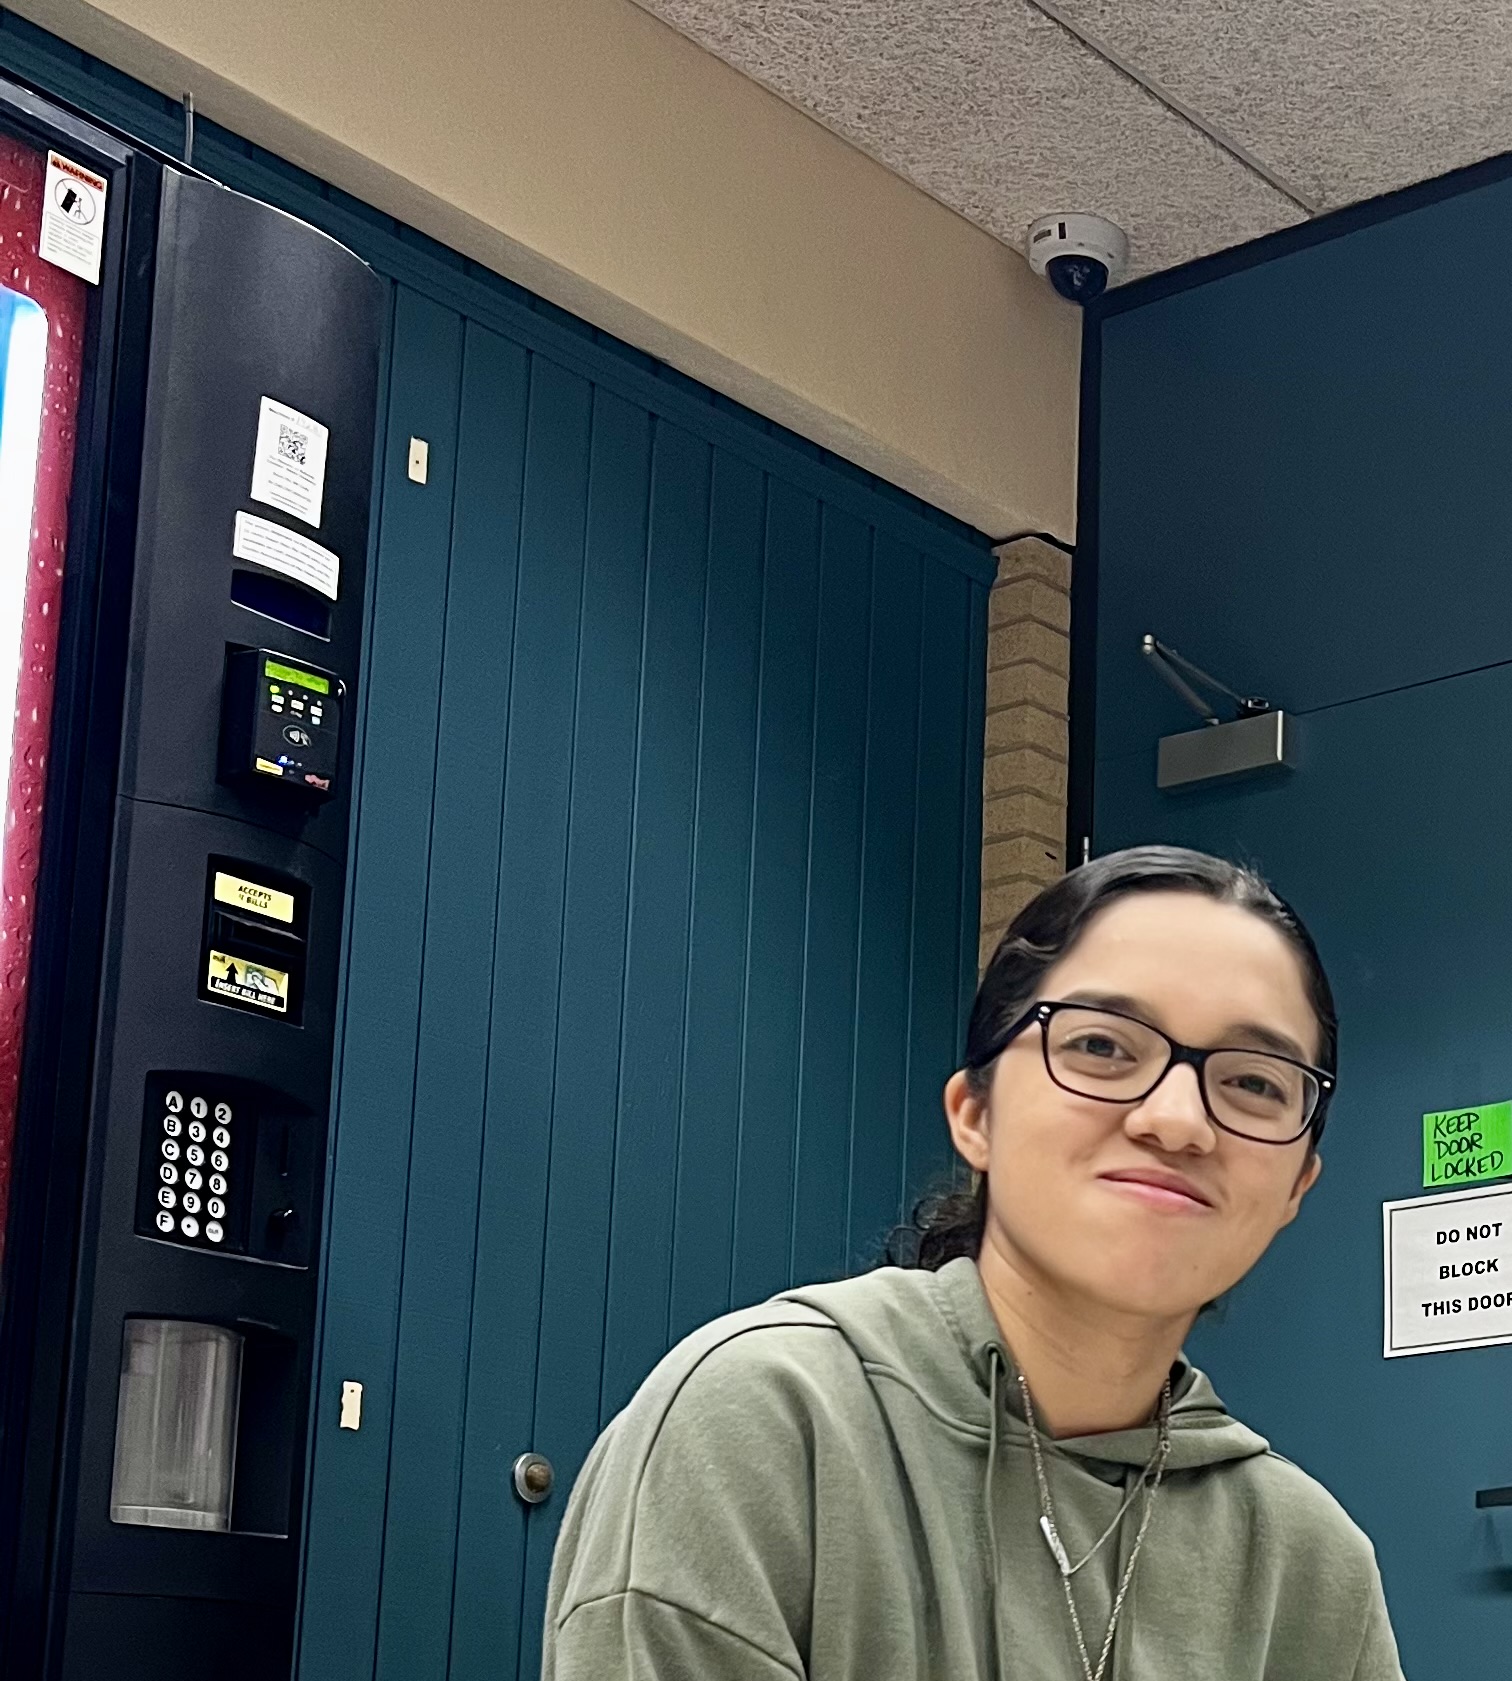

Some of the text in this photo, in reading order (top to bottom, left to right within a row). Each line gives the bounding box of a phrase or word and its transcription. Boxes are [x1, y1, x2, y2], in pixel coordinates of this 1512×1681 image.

[60, 161, 103, 190] WARNING
[238, 885, 272, 901] ACCEPTS
[246, 896, 268, 909] BILLS
[215, 978, 276, 1005] INSERT BILL HERE
[167, 1096, 178, 1110] A
[218, 1107, 227, 1120] 2
[167, 1119, 224, 1144] B 3 4
[1433, 1112, 1480, 1139] KEEP
[164, 1143, 222, 1167] C 5 6
[1433, 1132, 1483, 1160] DOOR
[1431, 1151, 1504, 1182] LOCKED
[163, 1167, 221, 1190] D 7 8
[161, 1191, 219, 1214] E 9 0
[159, 1215, 169, 1227] F
[1436, 1222, 1503, 1245] DO NOT
[1439, 1258, 1499, 1280] BLOCK
[1421, 1299, 1462, 1317] THIS
